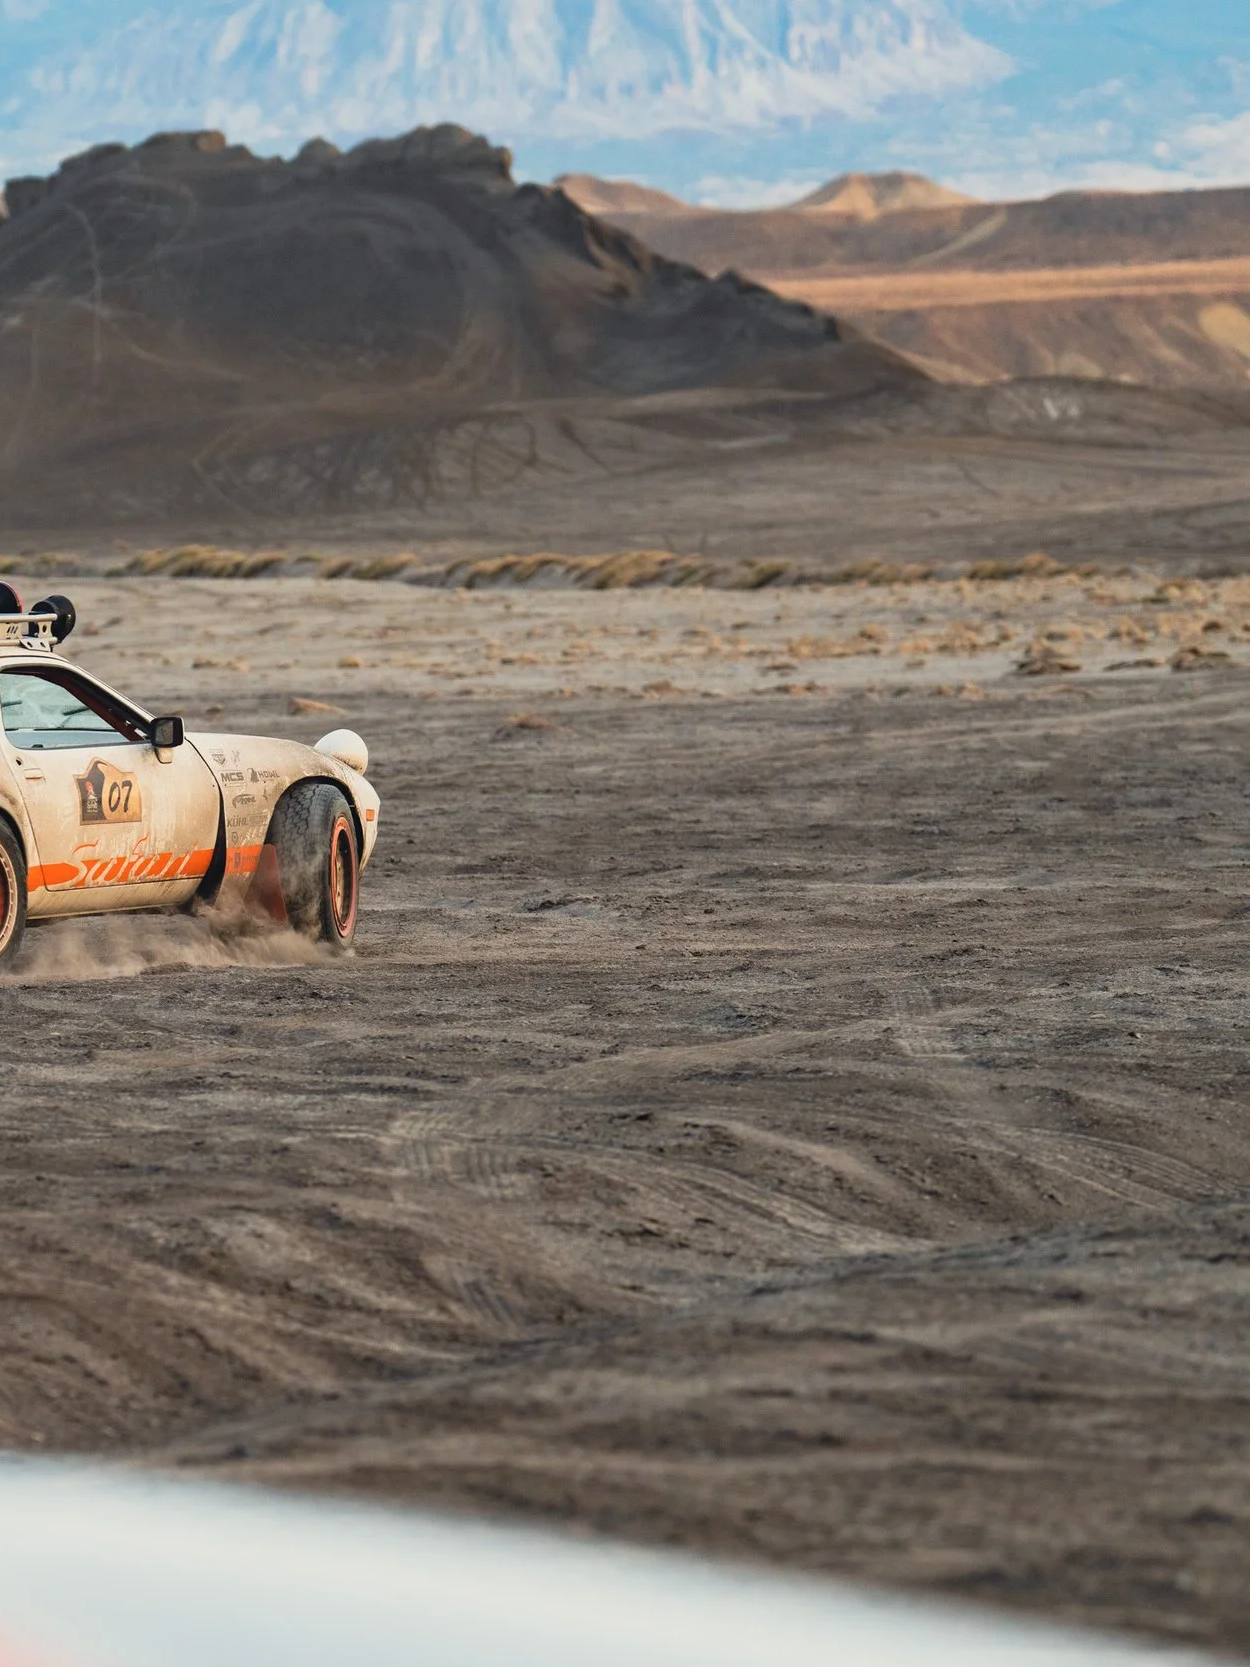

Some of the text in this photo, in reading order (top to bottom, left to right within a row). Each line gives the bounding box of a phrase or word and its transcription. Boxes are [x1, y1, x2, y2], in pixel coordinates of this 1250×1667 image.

[220, 771, 245, 782] MCS
[258, 770, 281, 779] HOWL
[108, 779, 133, 813] 07
